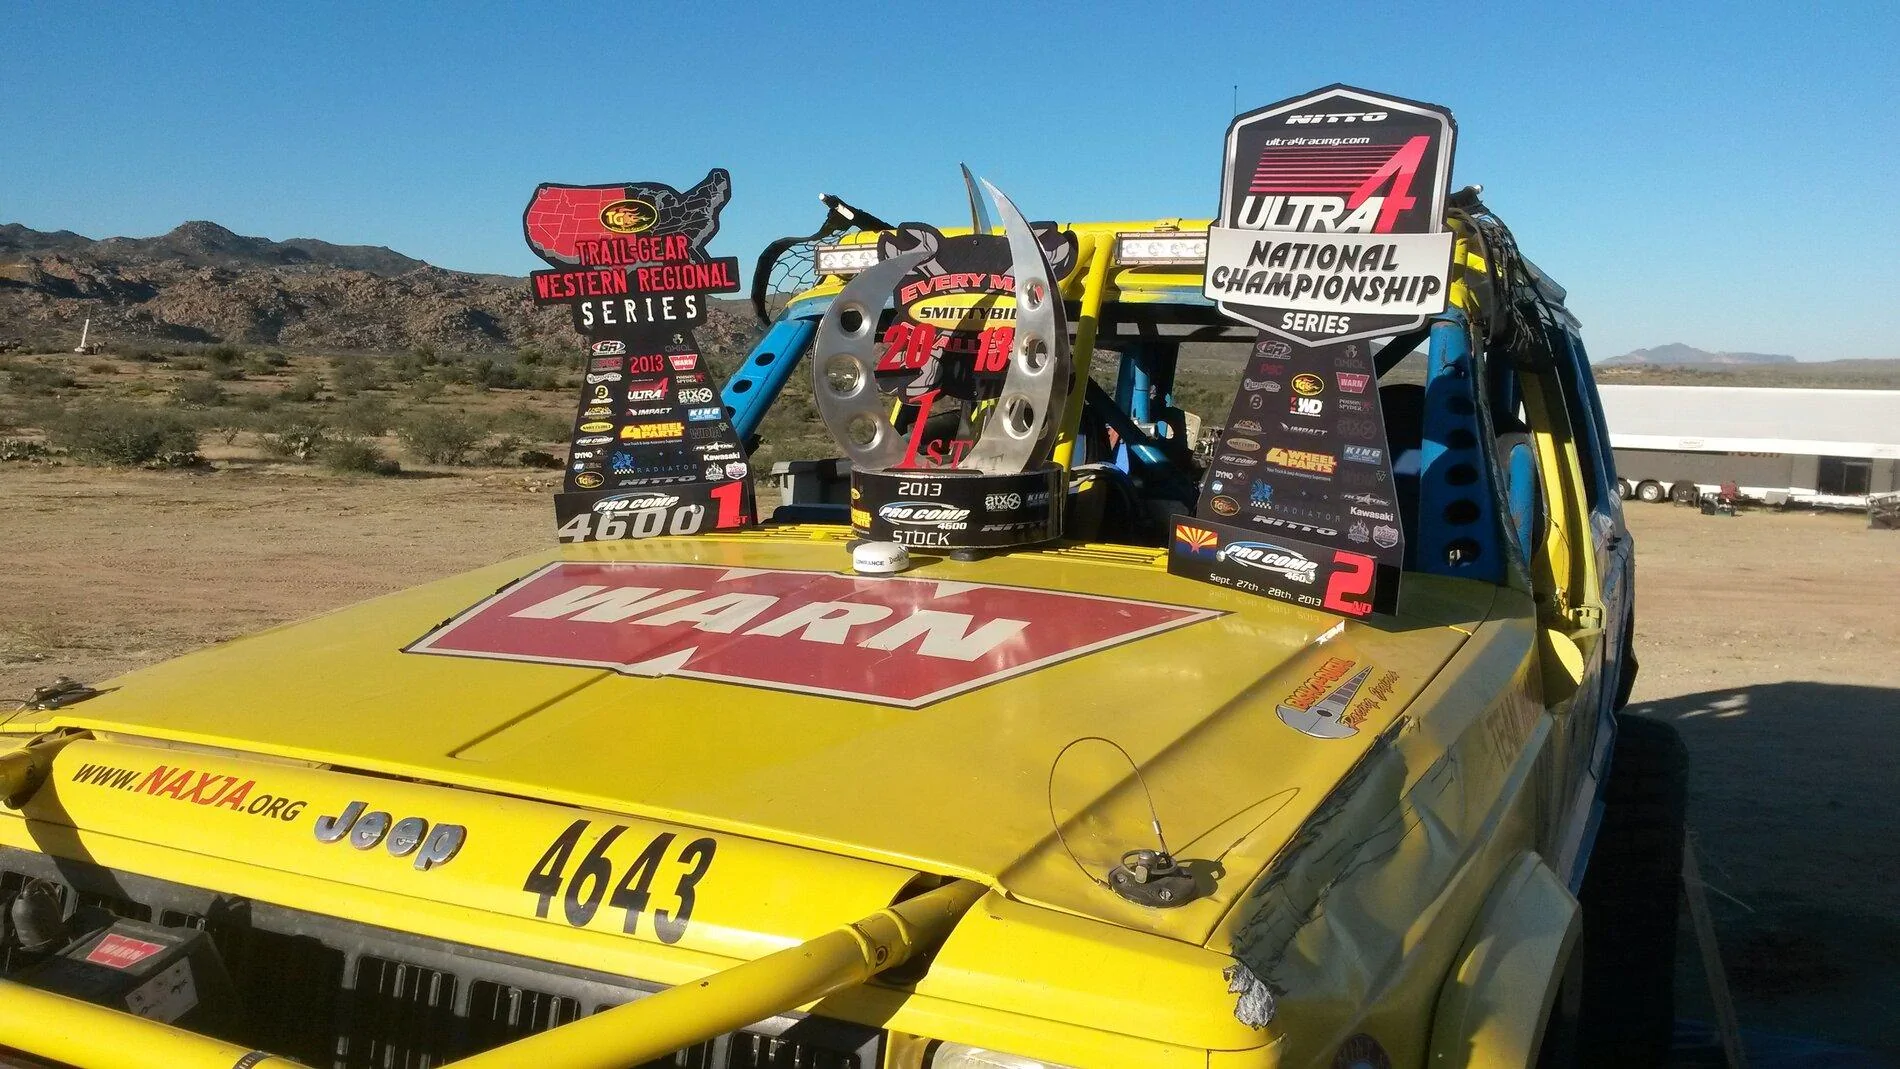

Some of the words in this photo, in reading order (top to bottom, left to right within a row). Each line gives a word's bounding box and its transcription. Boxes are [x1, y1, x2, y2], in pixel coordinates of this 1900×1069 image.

[1285, 112, 1388, 125] NITTO
[1265, 136, 1370, 147] ultra4racing.com
[1246, 240, 1399, 273] NATIONAL
[535, 268, 629, 299] WESTERN
[638, 262, 737, 292] REGIONAL
[1210, 265, 1441, 305] CHAMPIONSHIP
[901, 272, 987, 306] EVERY
[581, 294, 698, 327] SERIES
[919, 306, 1017, 319] SMITTYBIL
[1281, 312, 1351, 335] SERIES
[630, 354, 665, 374] 2013
[1341, 379, 1364, 387] WARN
[637, 407, 673, 416] IMPACT
[690, 407, 720, 416] KING
[620, 424, 642, 440] 4
[640, 421, 685, 432] WHEEL
[640, 430, 684, 440] PARTS
[1290, 425, 1328, 436] IMPACT
[574, 451, 594, 460] DYNO
[703, 451, 741, 461] Kawasaki
[1287, 449, 1337, 464] WHEEL
[1344, 446, 1381, 457] KING
[637, 463, 698, 473] RADIATOR
[1236, 457, 1258, 466] COMP
[1287, 459, 1334, 474] PARTS
[618, 475, 697, 487] NITTO
[1215, 470, 1234, 480] DYNO
[898, 482, 943, 497] 2013
[593, 499, 626, 512] PRO
[629, 495, 680, 510] COMP
[879, 506, 908, 518] PRO
[909, 507, 971, 522] COMP
[1274, 504, 1341, 523] RADIATOR
[1350, 506, 1394, 522] Kawasaki
[558, 504, 706, 544] 4600
[937, 522, 968, 530] 4600
[1252, 514, 1338, 536] NITTO
[892, 530, 951, 545] STOCK
[1225, 545, 1260, 562] PRO
[1261, 549, 1319, 572] COMP
[1209, 573, 1233, 586] Sept.
[1236, 579, 1259, 592] 27th
[1268, 587, 1294, 601] 28th.
[1297, 594, 1322, 607] 2013
[507, 585, 1031, 662] WARN
[72, 763, 308, 822] WWW.NAXJA.ORG
[313, 801, 468, 872] Jeep
[522, 818, 718, 945] 4643
[100, 943, 146, 961] WARN
